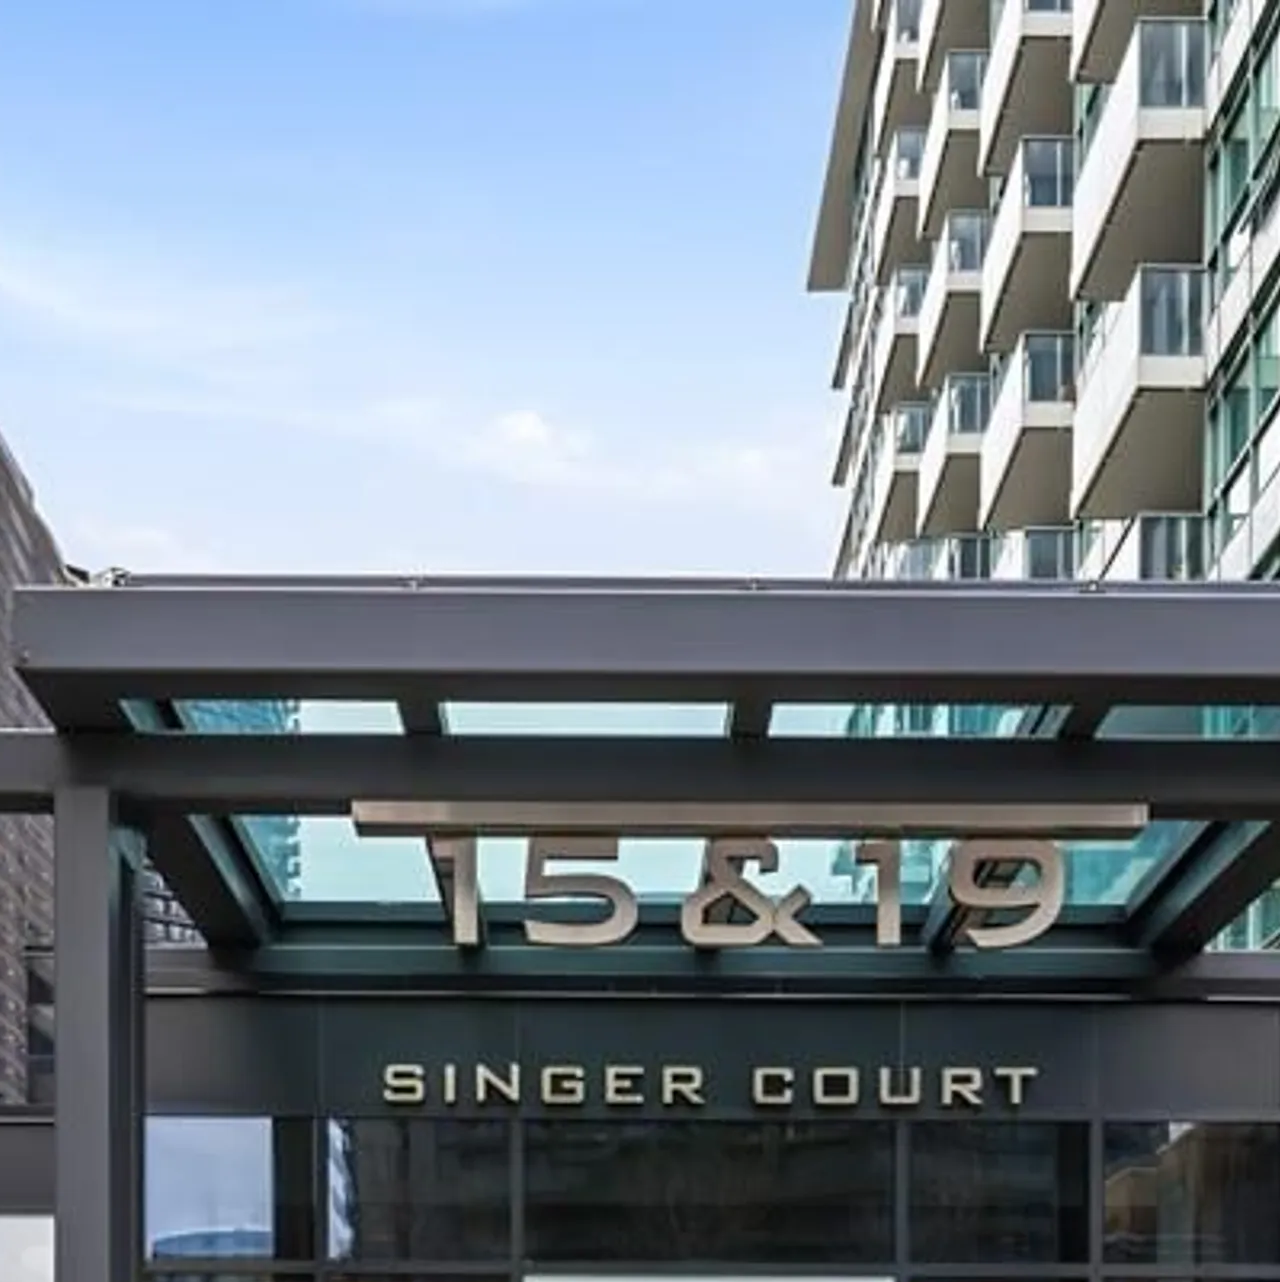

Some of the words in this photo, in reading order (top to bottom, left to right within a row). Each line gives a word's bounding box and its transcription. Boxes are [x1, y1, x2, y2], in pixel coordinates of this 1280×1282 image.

[428, 837, 638, 946] 15
[681, 837, 823, 947] &
[854, 837, 1065, 948] 19
[382, 1063, 705, 1105] SINGER
[751, 1066, 1039, 1105] COURT
